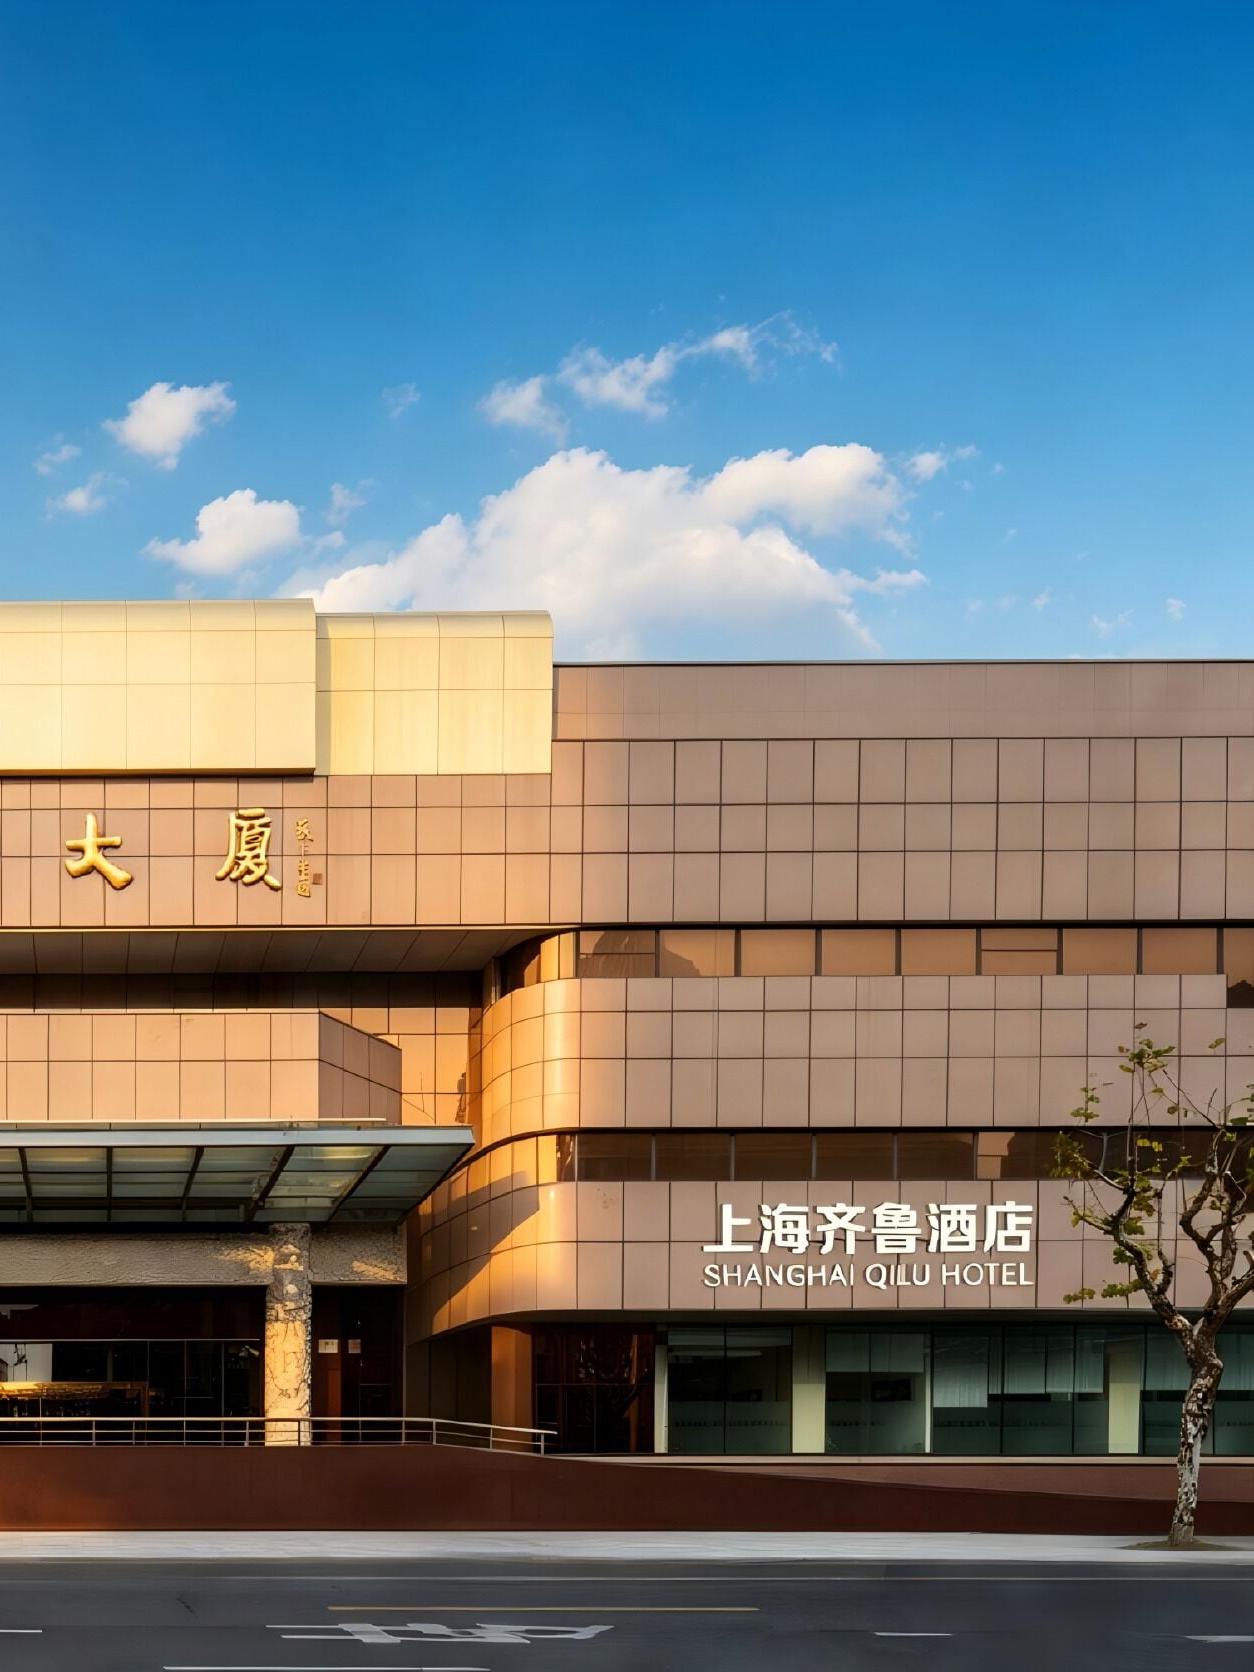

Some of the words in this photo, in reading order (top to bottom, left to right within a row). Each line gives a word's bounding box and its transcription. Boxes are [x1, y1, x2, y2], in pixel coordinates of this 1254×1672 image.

[702, 1202, 1033, 1255] 上海齐鲁酒店
[702, 1263, 855, 1288] SHANGHAI
[864, 1263, 931, 1290] QILU
[941, 1262, 1035, 1286] HOTEL
